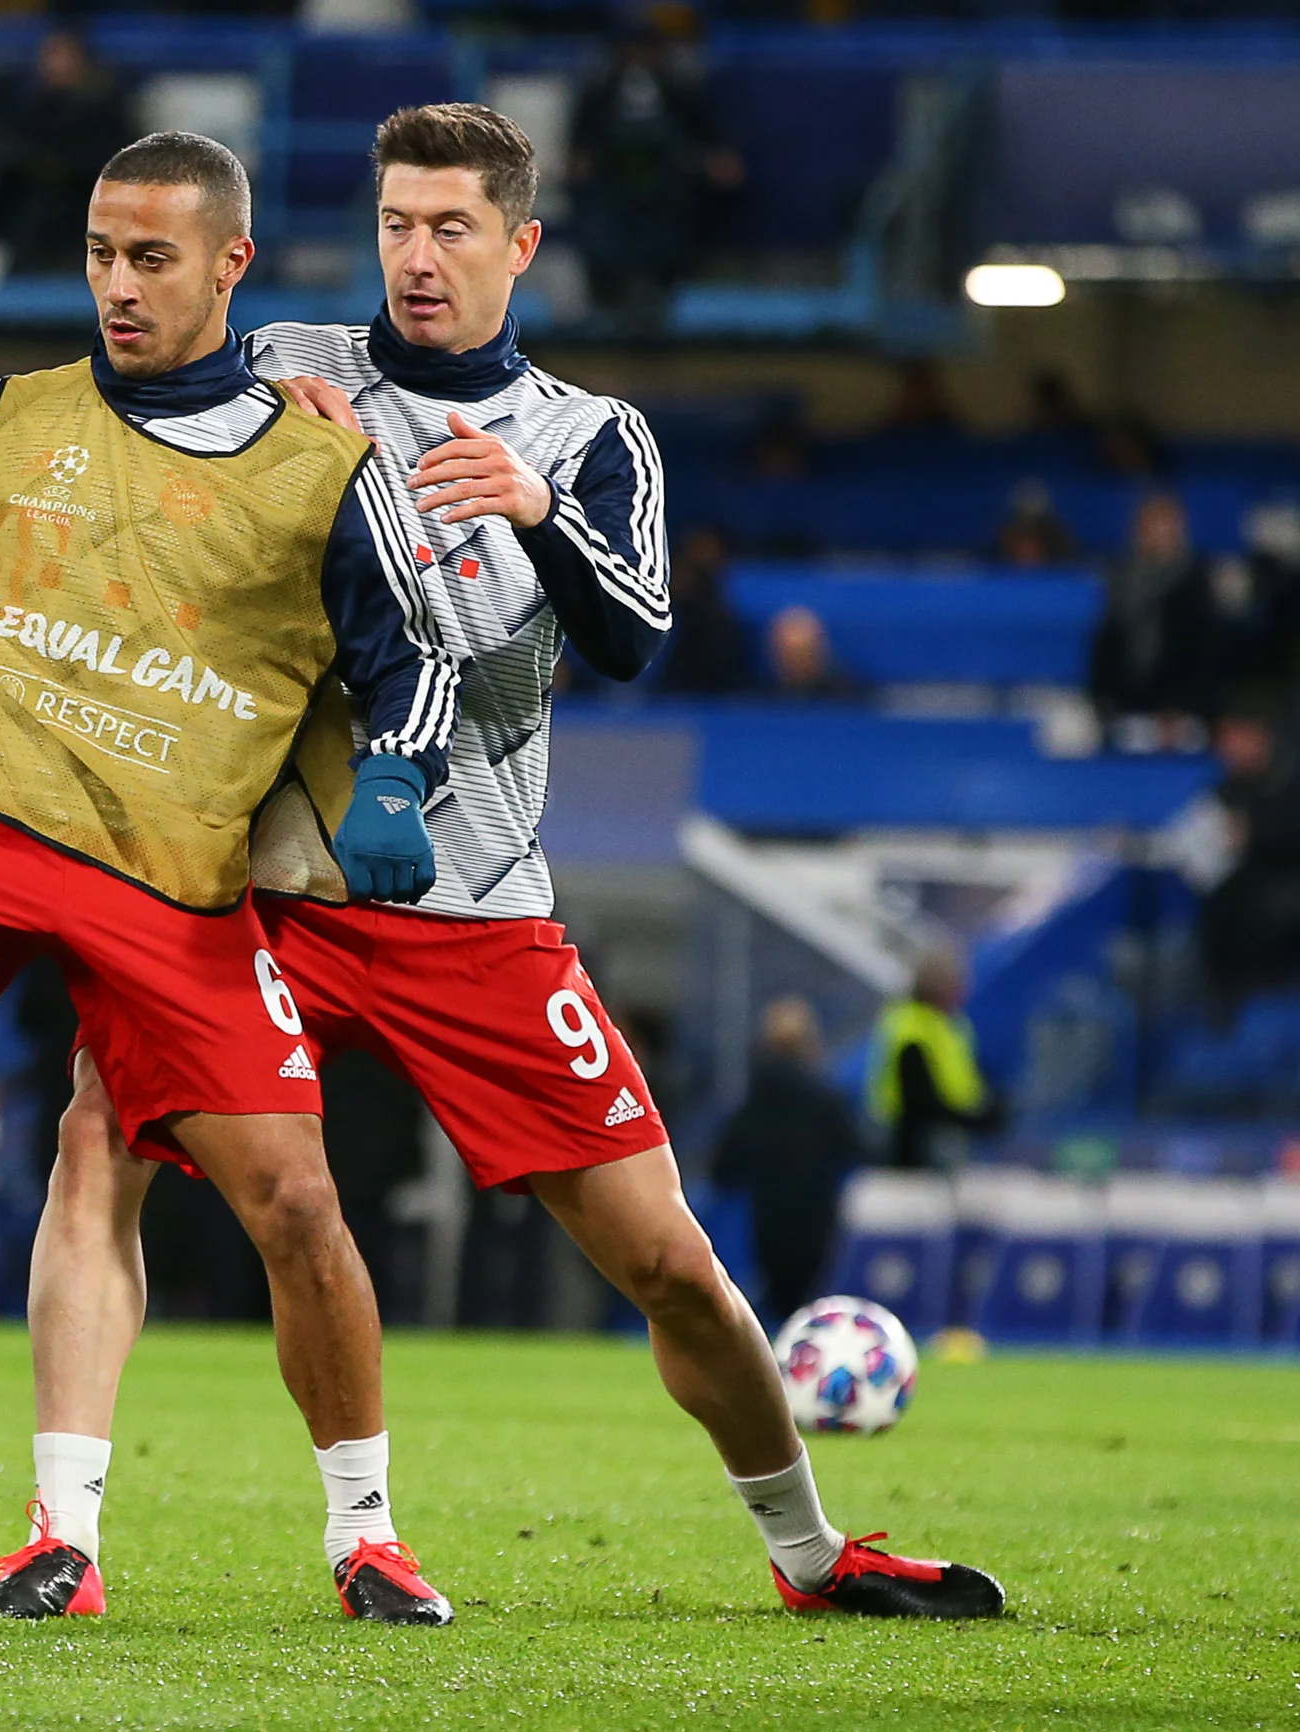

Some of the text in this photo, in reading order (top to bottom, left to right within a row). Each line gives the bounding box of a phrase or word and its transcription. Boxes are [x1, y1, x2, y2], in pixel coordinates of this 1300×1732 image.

[9, 494, 97, 521] CHAMPIONS
[26, 508, 72, 528] LEAGUE
[35, 690, 178, 762] RESPECT
[254, 948, 303, 1036] 6
[546, 988, 610, 1080] 9
[278, 1065, 317, 1081] adidas
[604, 1104, 646, 1128] adidas
